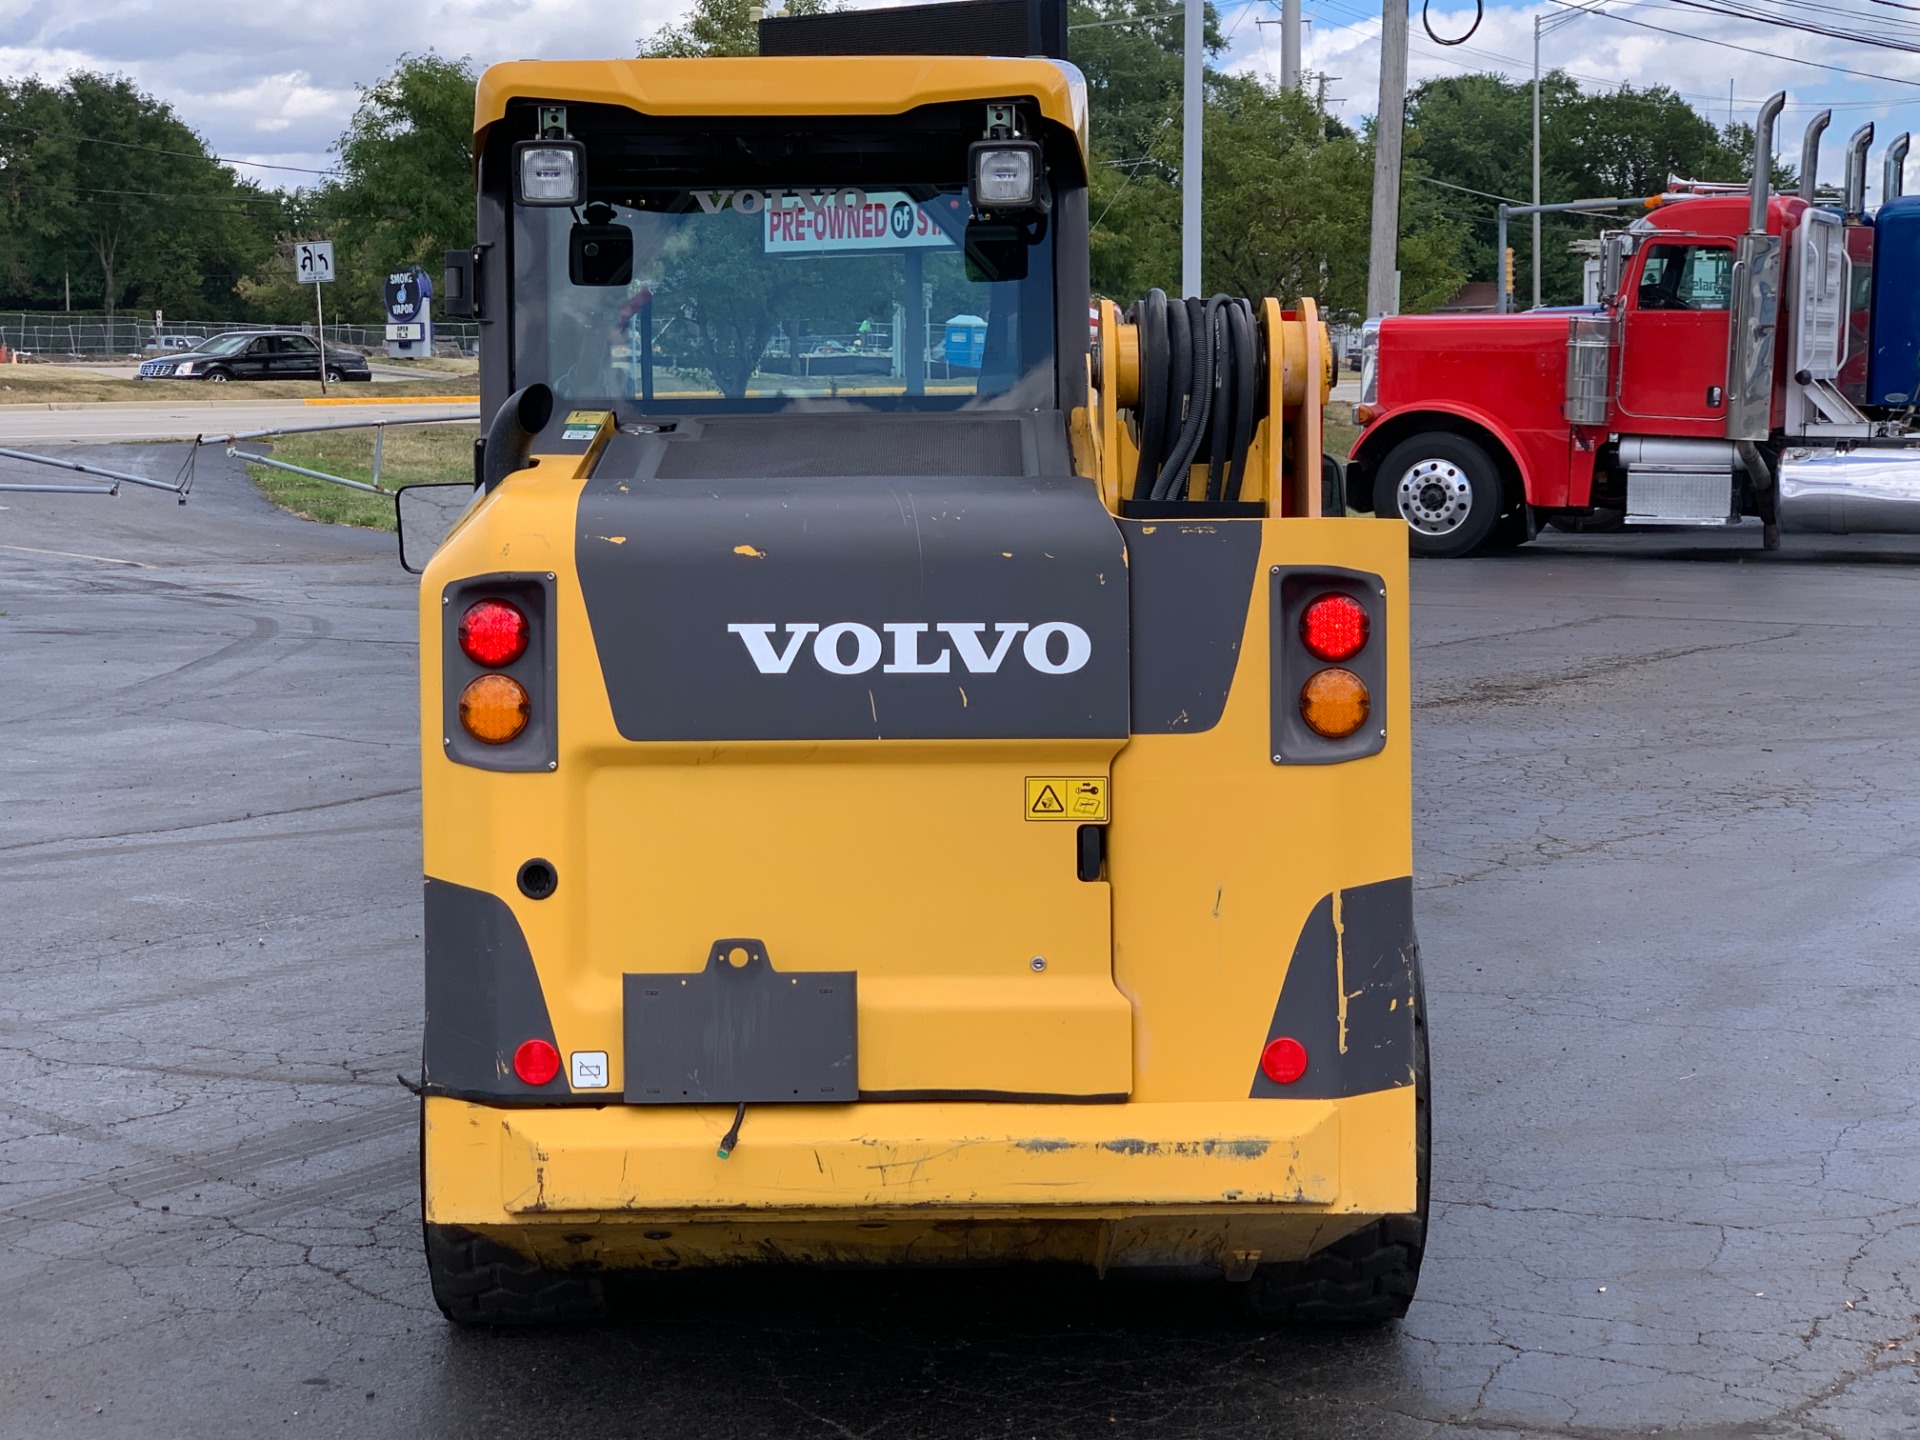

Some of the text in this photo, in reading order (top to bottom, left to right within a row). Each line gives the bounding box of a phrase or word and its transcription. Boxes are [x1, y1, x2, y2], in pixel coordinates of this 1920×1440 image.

[689, 187, 867, 214] VOLVO
[769, 203, 888, 242] PRE-OWNED
[893, 205, 910, 232] of
[390, 272, 413, 285] SMOKE
[392, 303, 414, 315] VAPOR
[727, 621, 1092, 675] VOLVO
